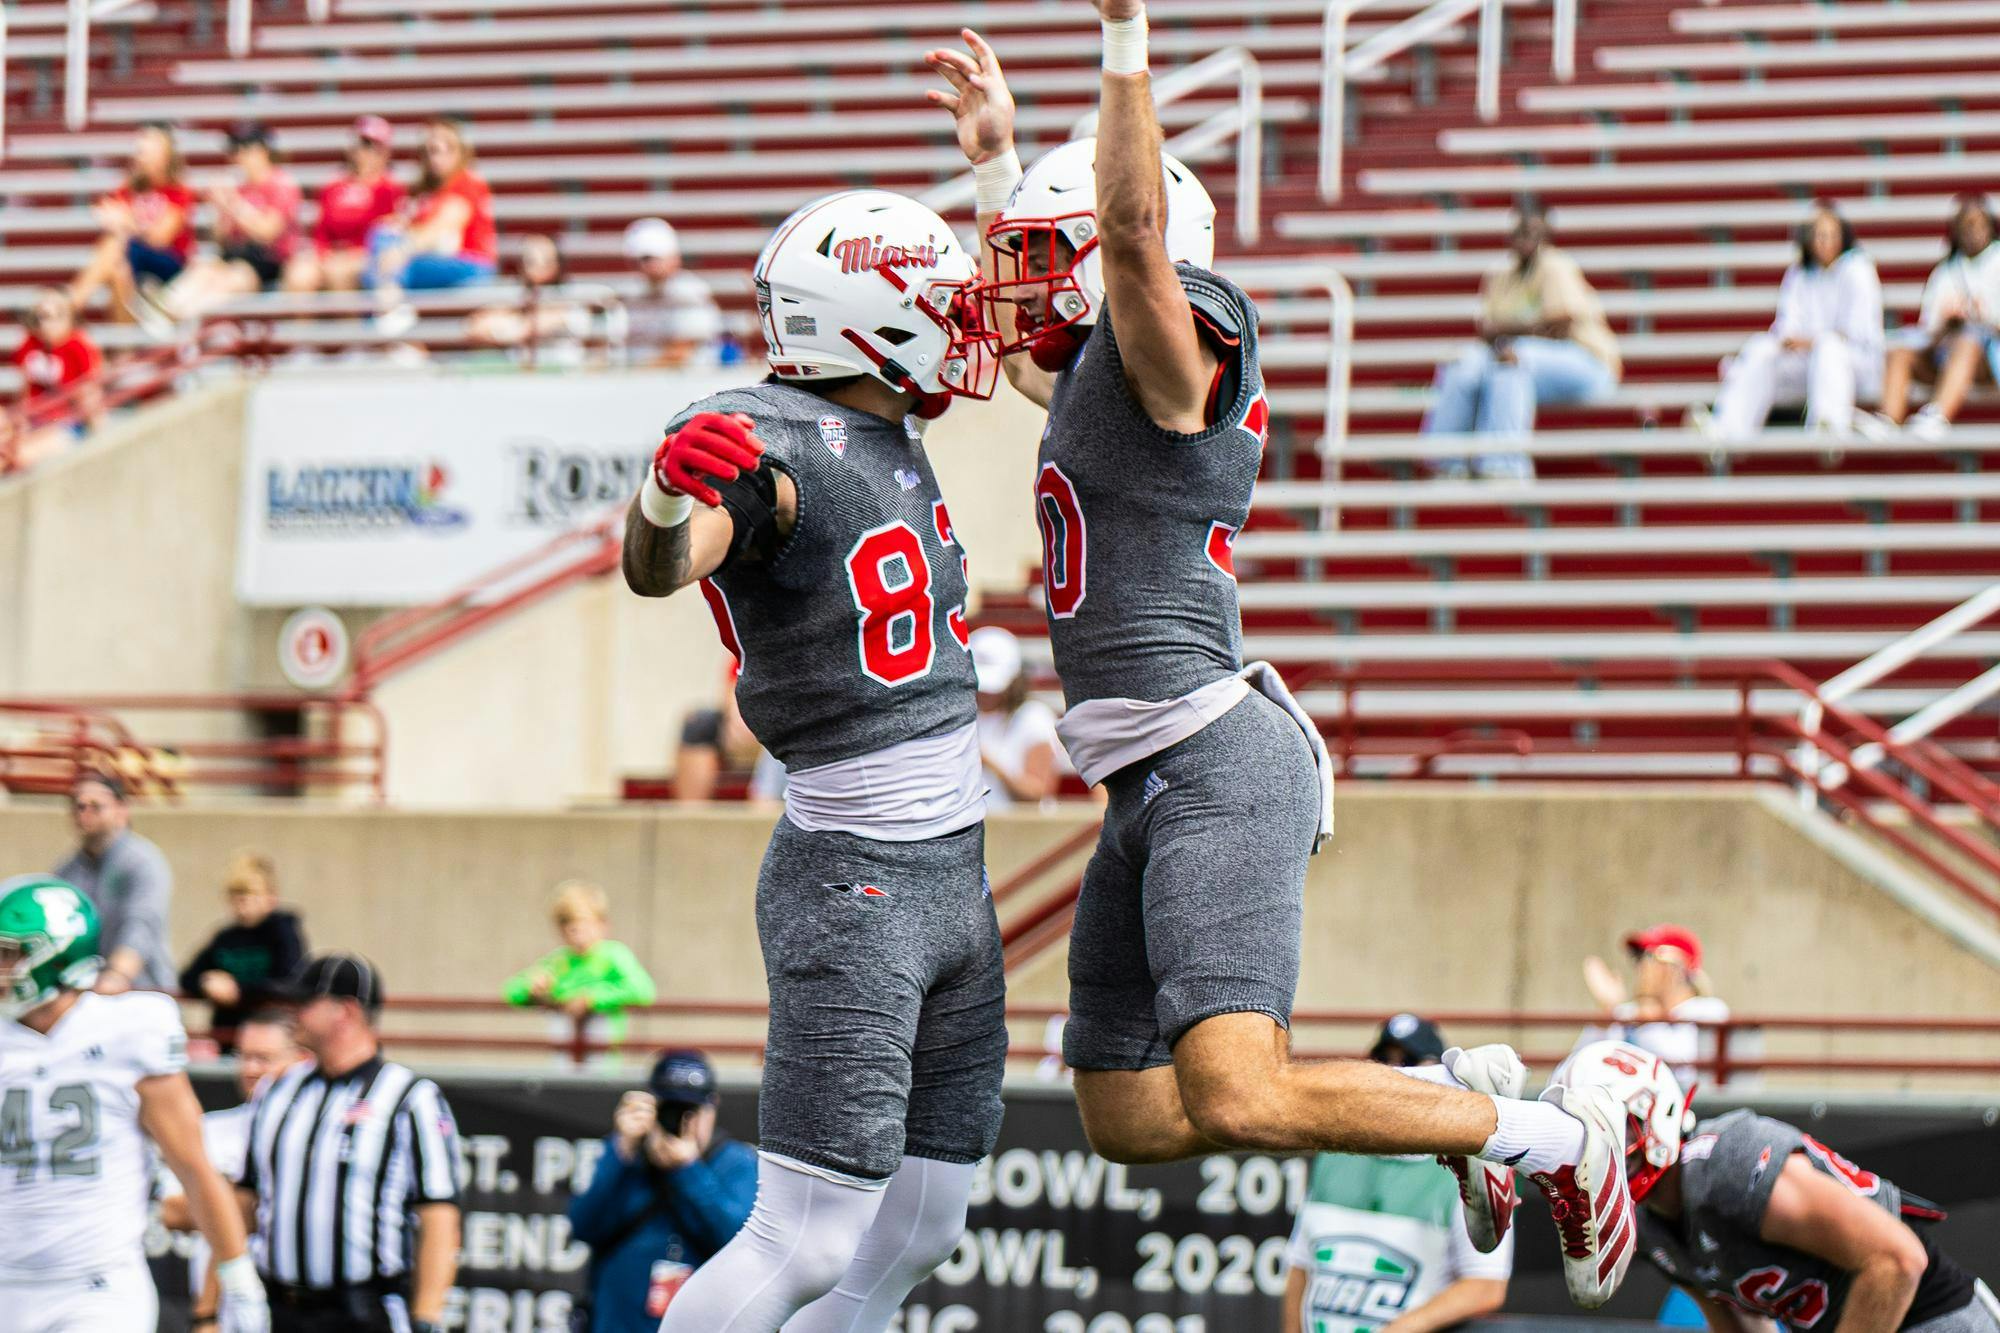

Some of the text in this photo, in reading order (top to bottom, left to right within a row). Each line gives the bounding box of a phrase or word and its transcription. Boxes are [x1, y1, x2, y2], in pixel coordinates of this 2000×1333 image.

[833, 234, 938, 274] Miami
[0, 1083, 99, 1180] 42
[1131, 1231, 1291, 1297] 2020
